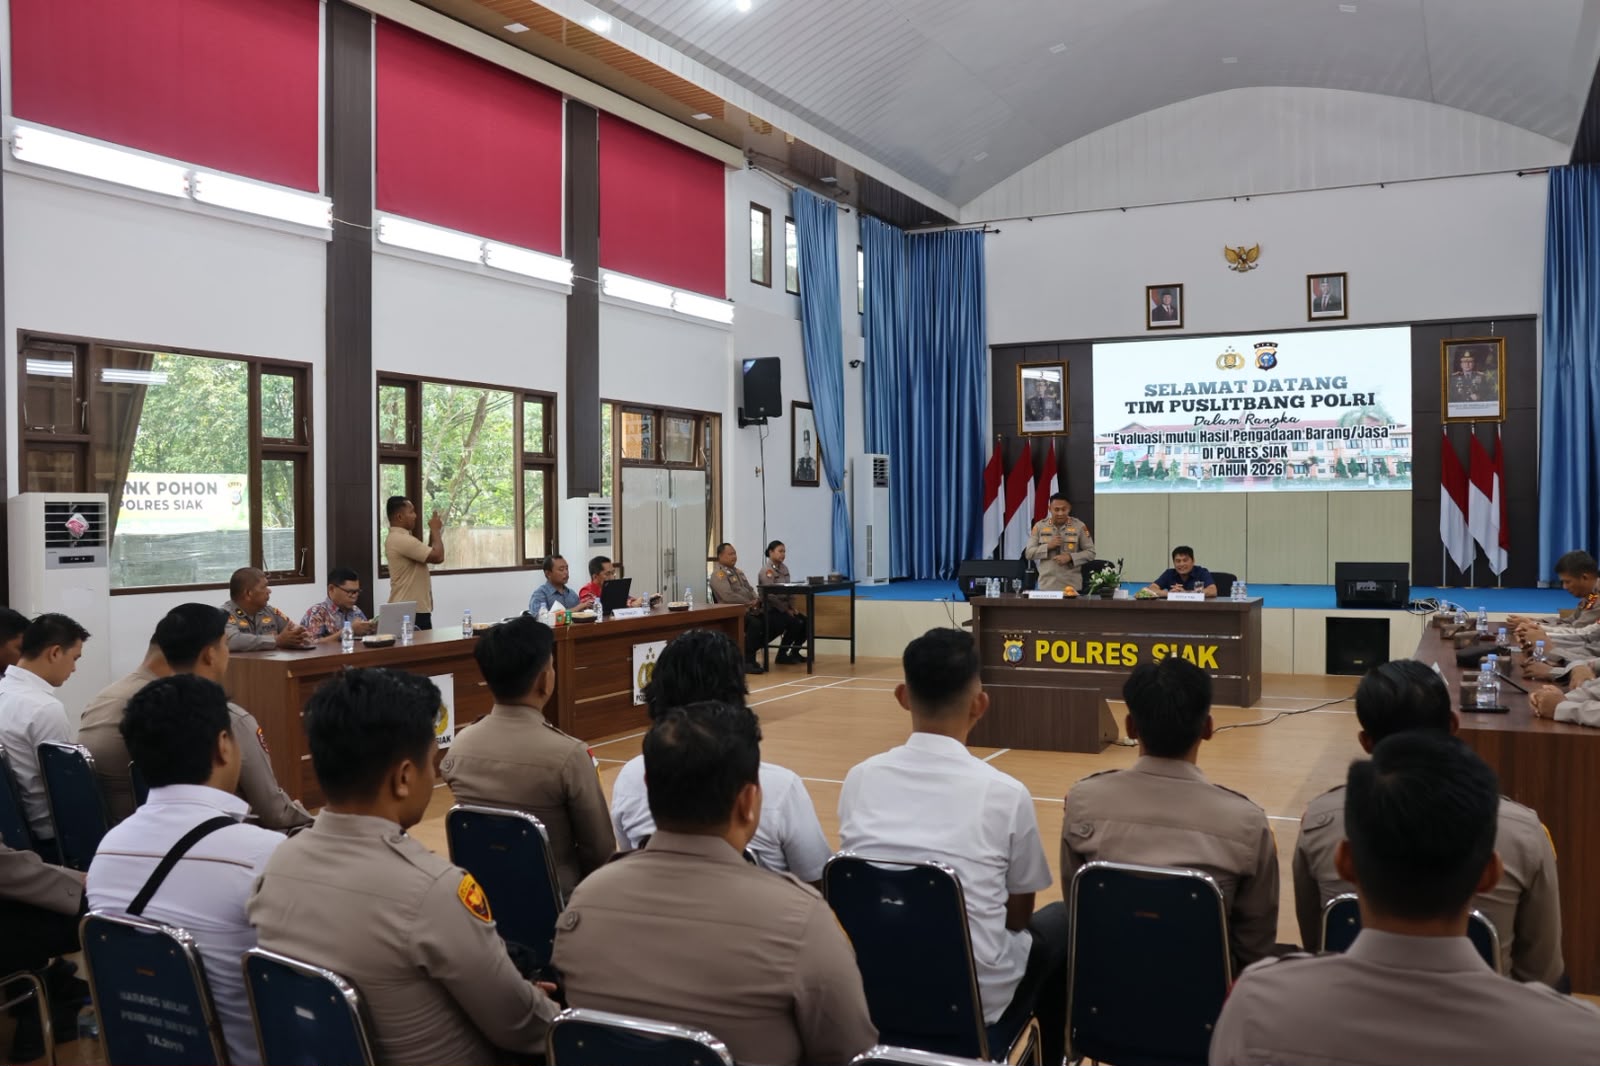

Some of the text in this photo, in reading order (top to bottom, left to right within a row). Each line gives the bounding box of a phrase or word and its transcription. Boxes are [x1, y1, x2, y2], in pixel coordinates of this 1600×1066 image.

[1144, 376, 1348, 397] SELAMAT DATANG
[1124, 392, 1375, 414] TIM PUSLITBANG POLRI
[1193, 411, 1300, 428] Dalam Rangka
[1165, 432, 1196, 444] mutu
[1200, 430, 1229, 442] Hasil
[1233, 428, 1301, 444] Pengadaan
[1202, 445, 1288, 460] DI POLRES SIAK
[1212, 463, 1283, 476] TAHUN 2026
[122, 481, 217, 495] NK POHON
[174, 500, 203, 510] SIAK
[1035, 640, 1219, 669] POLRES SIAK
